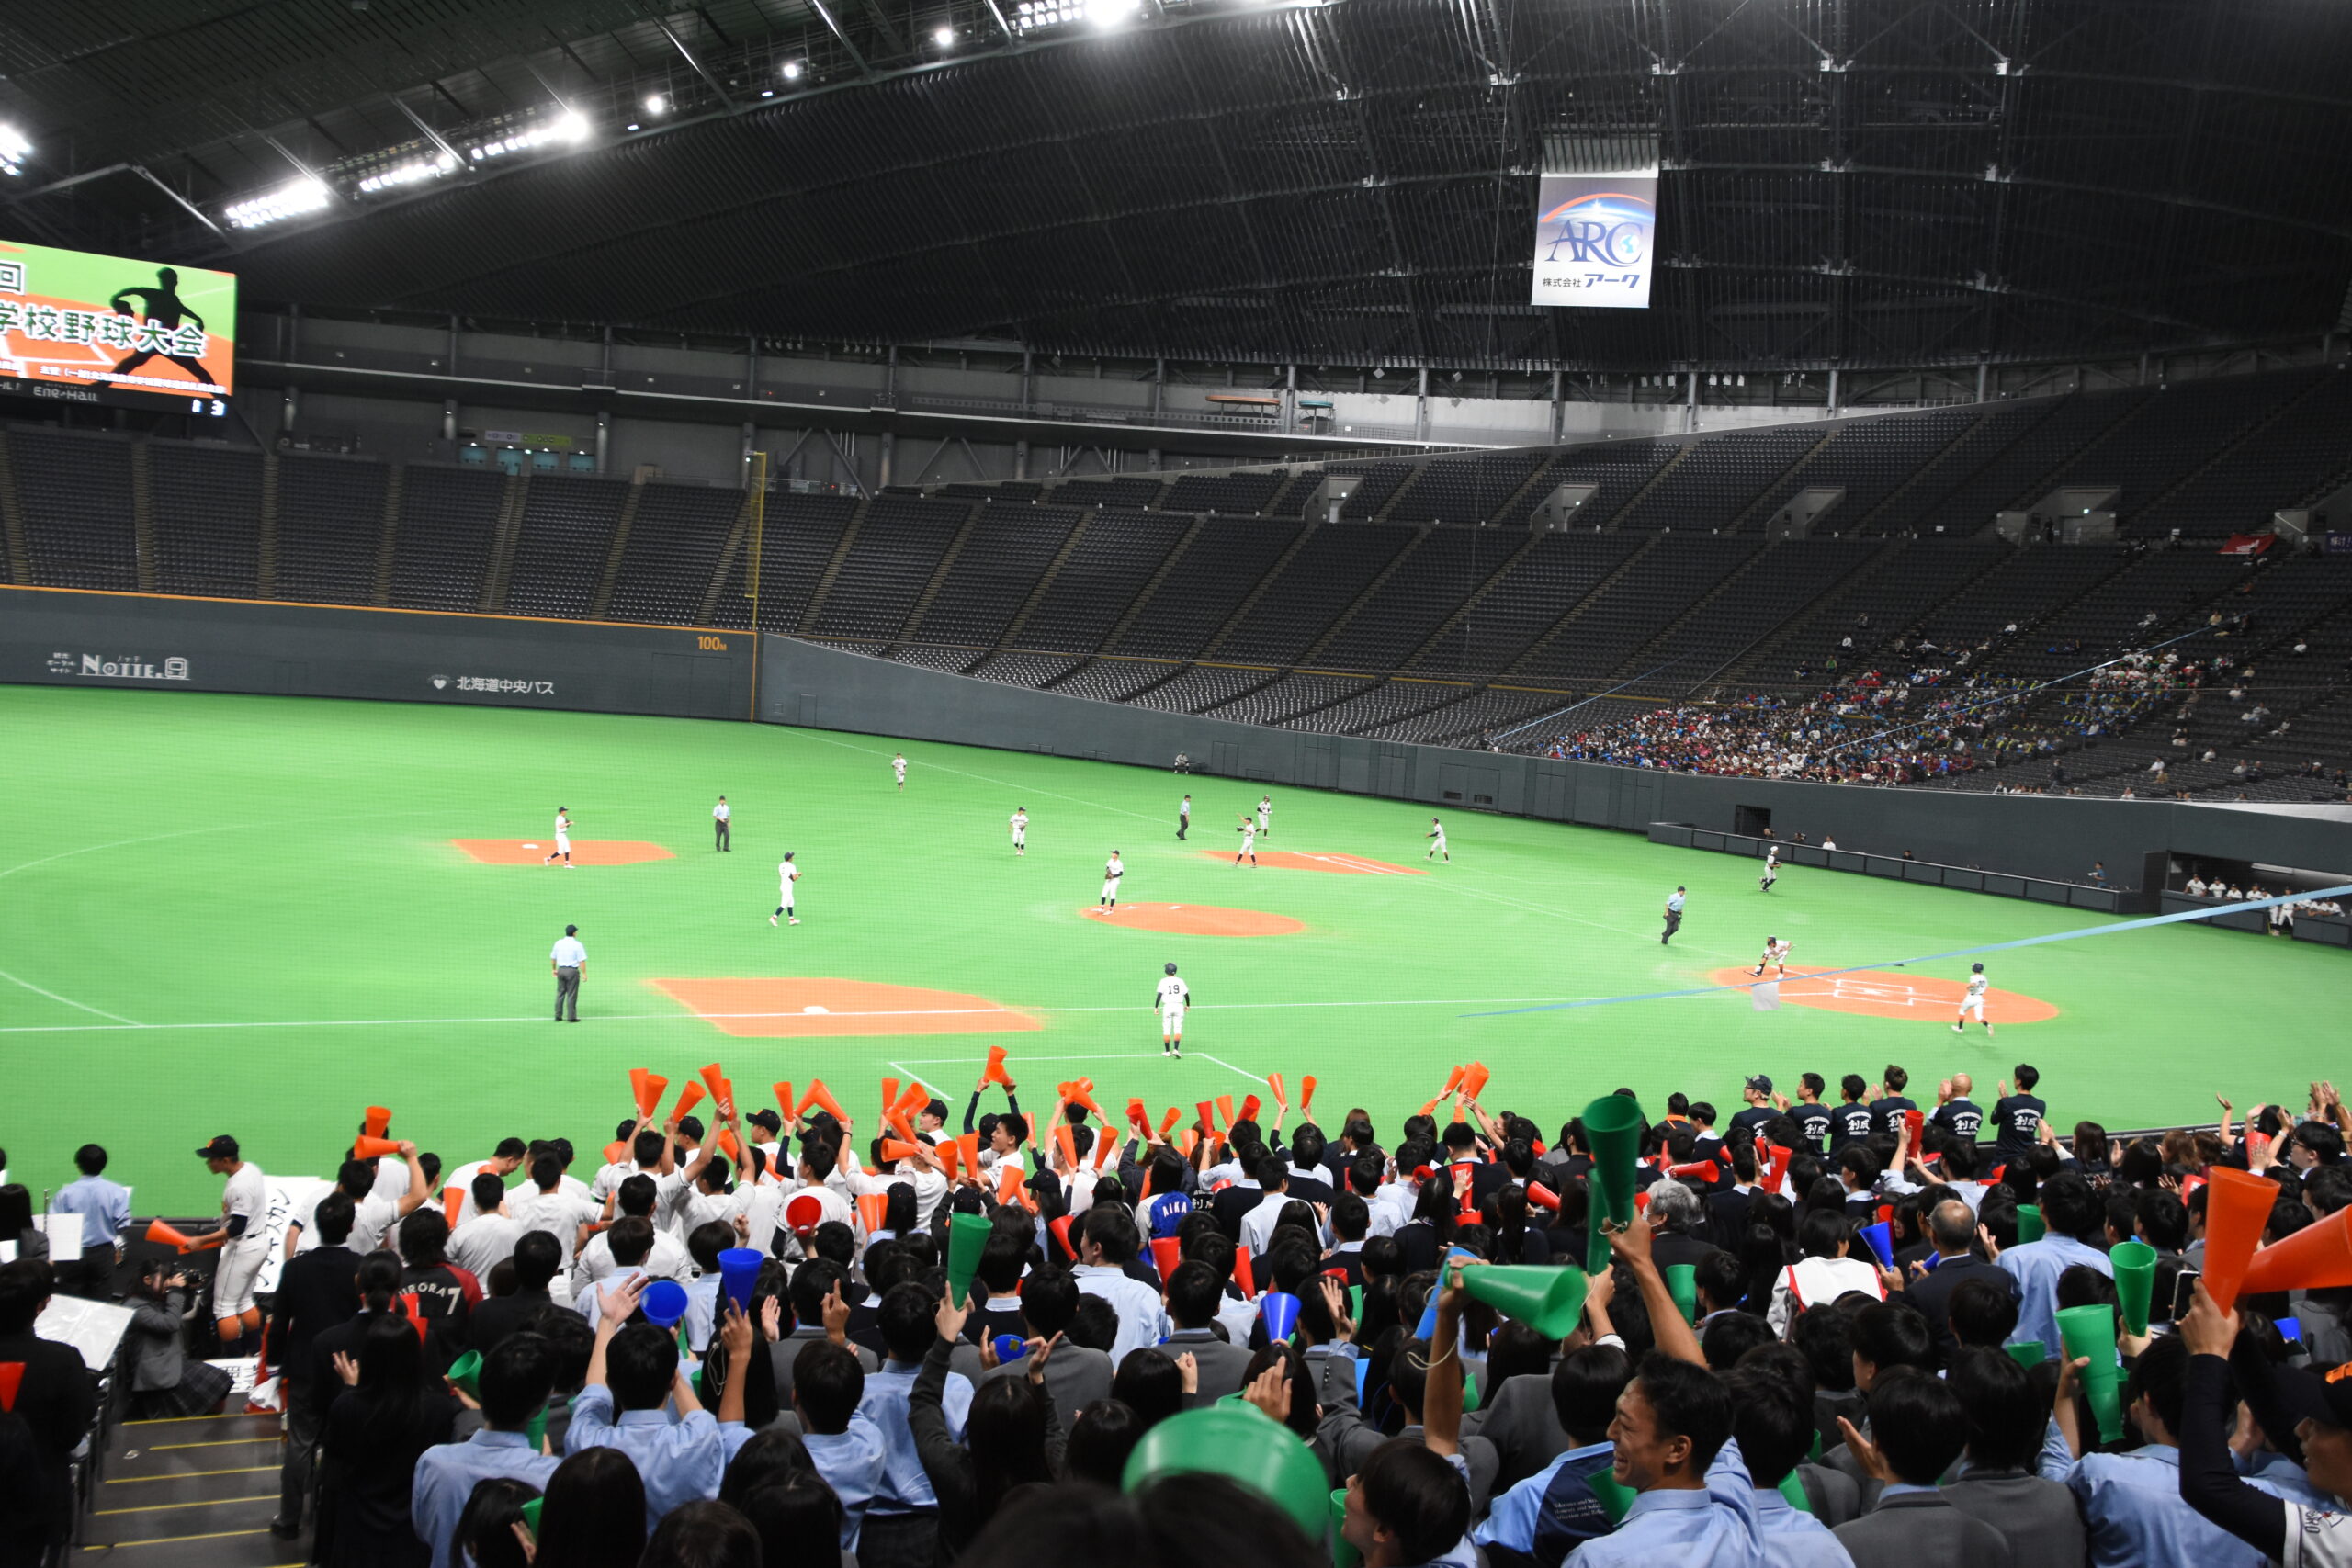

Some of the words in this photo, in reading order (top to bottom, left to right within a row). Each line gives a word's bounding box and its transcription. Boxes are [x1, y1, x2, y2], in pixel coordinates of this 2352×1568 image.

[1544, 220, 1643, 267] ARC
[457, 676, 555, 694] 北海道中央バス
[1168, 984, 1180, 995] 19
